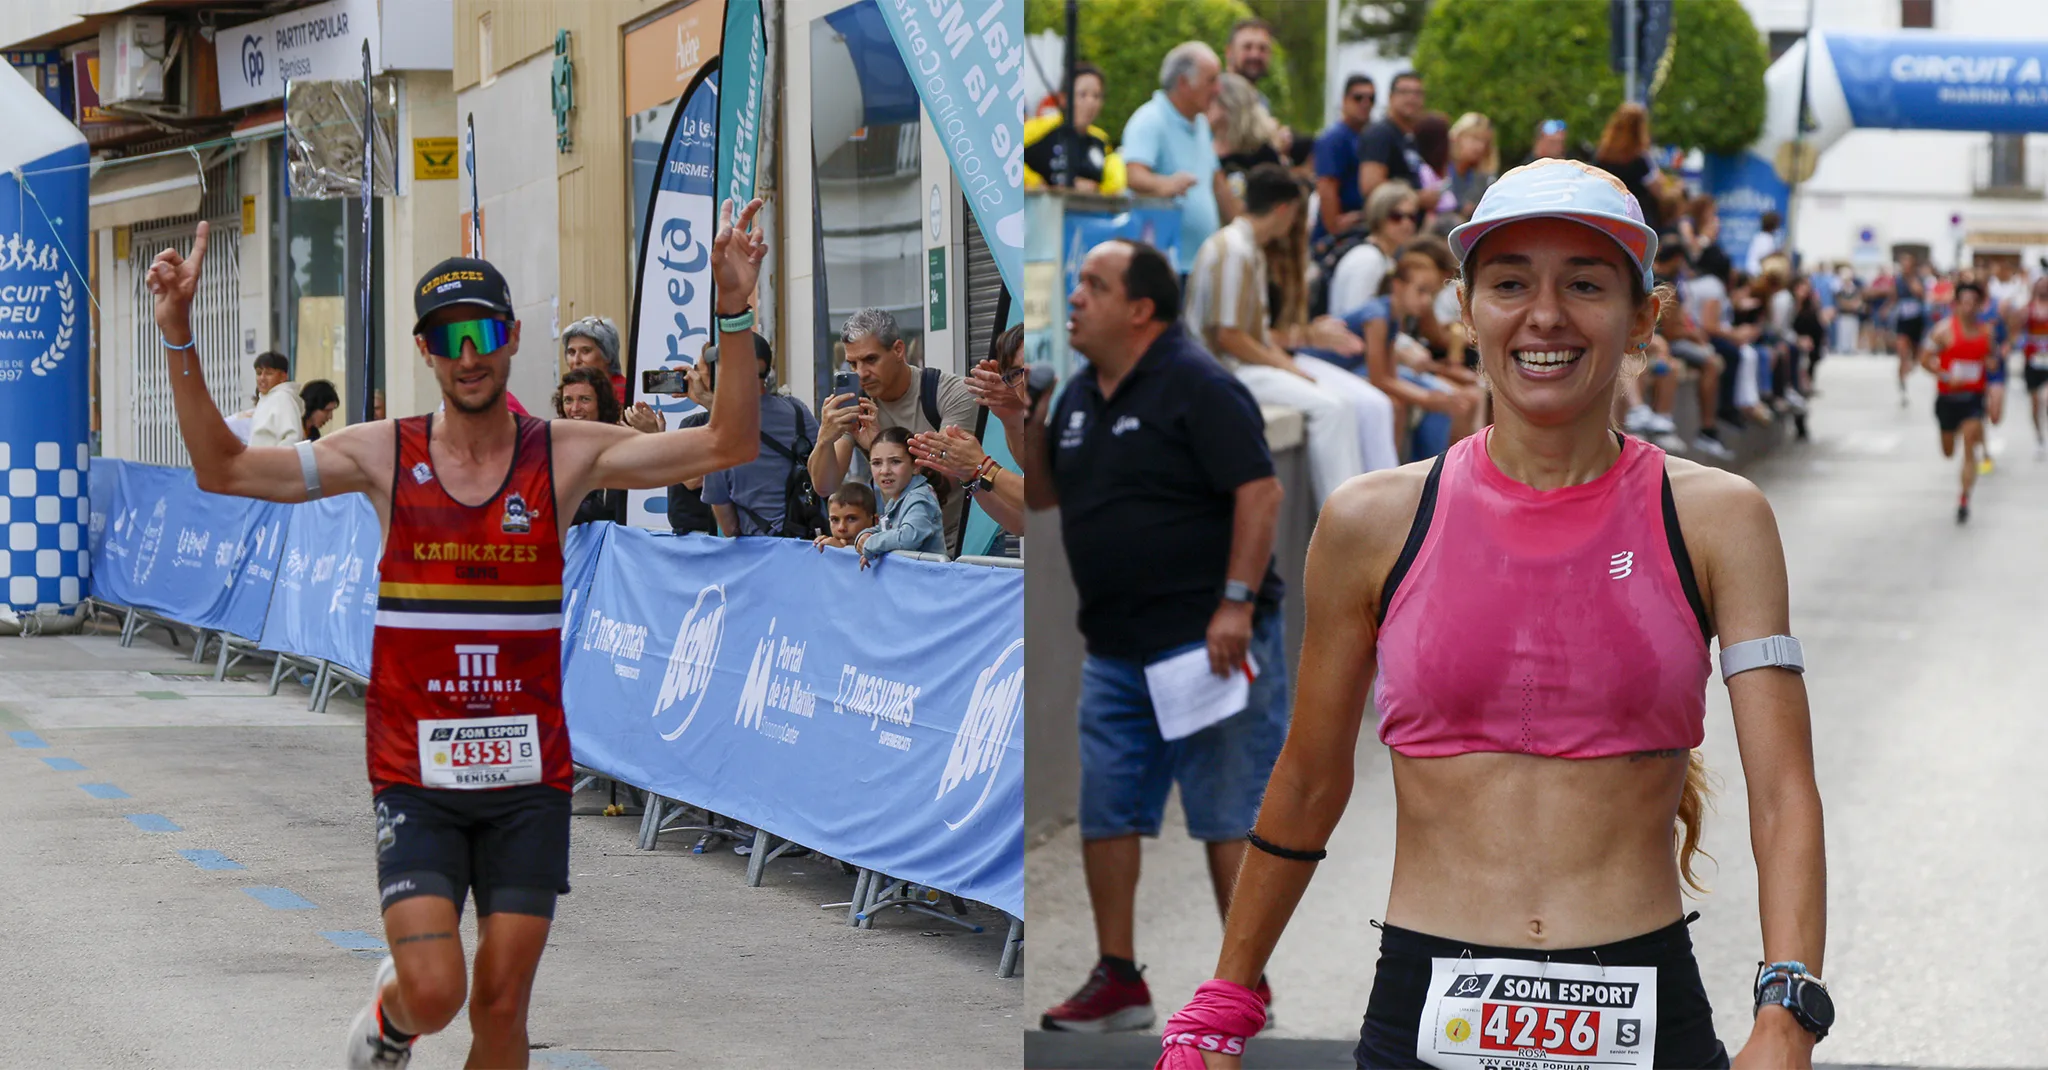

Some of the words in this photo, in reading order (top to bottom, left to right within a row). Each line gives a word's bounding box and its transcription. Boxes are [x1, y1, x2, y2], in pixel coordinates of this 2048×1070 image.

[276, 23, 306, 51] PARTIT
[309, 13, 349, 43] POPULAR
[278, 56, 312, 80] Benissa
[1890, 55, 2016, 83] CIRCUIT
[2015, 57, 2041, 85] A
[421, 271, 485, 296] KAMIKAZES
[0, 285, 51, 303] CUIT
[17, 330, 45, 339] ALTA
[413, 542, 538, 563] KAMIKAZES
[455, 566, 499, 579] GANG
[776, 636, 806, 673] Portal
[427, 679, 522, 692] MARTINEZ
[767, 674, 781, 708] de
[779, 677, 791, 711] la
[788, 679, 816, 719] Marina
[460, 728, 485, 739] SOM
[488, 725, 526, 738] ESPORT
[453, 741, 511, 764] 4353
[522, 744, 531, 756] S
[456, 773, 507, 783] BENISSA
[1504, 979, 1550, 999] SOM
[1558, 983, 1632, 1004] ESPORT
[1484, 1005, 1596, 1052] 4256
[1620, 1023, 1636, 1043] S
[1517, 1048, 1547, 1058] ROSA
[1505, 1060, 1538, 1068] CURSA
